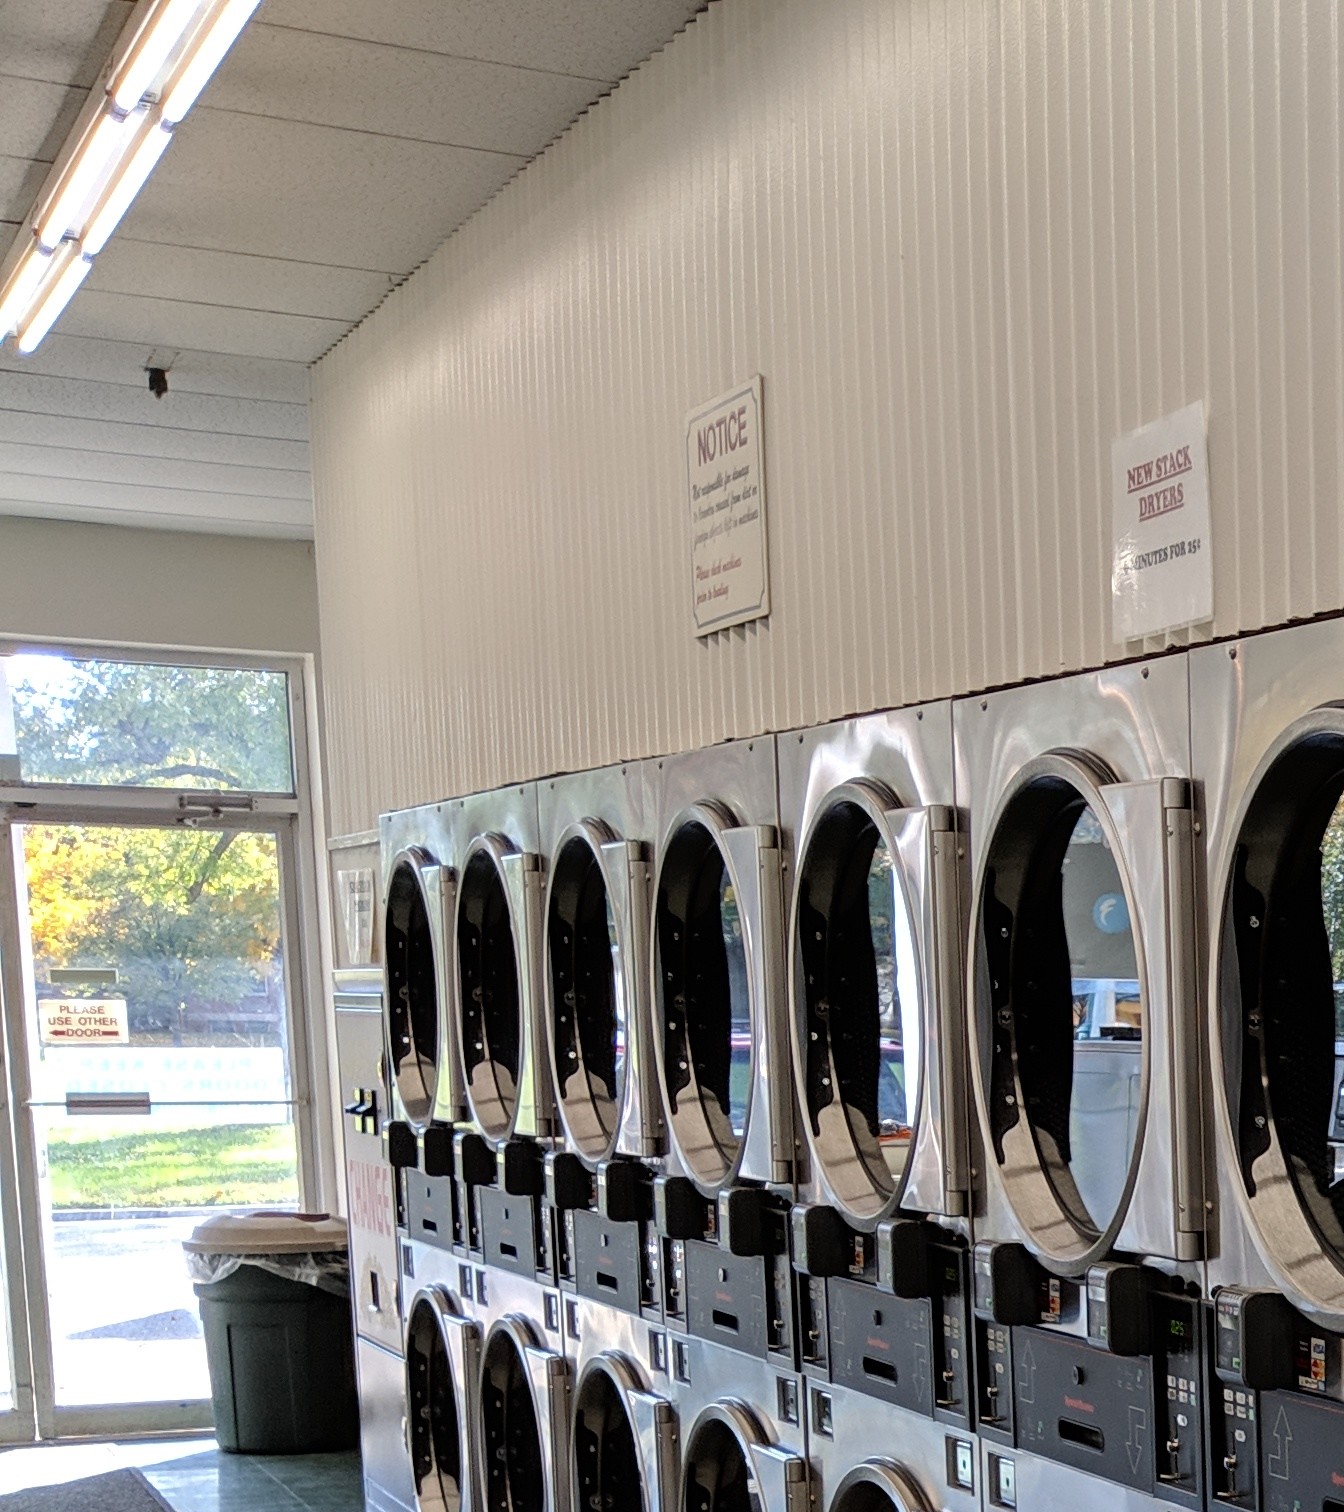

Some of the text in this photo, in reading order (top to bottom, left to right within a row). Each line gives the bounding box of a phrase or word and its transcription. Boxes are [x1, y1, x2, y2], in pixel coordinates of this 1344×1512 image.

[697, 404, 749, 467] NOTICE
[1127, 445, 1193, 490] NEW STACK
[1138, 482, 1185, 518] DRYERS
[1169, 541, 1187, 561] FOR
[59, 1005, 105, 1015] PLEASE
[48, 1016, 118, 1026] USE OTHER
[66, 1028, 102, 1038] DOOR
